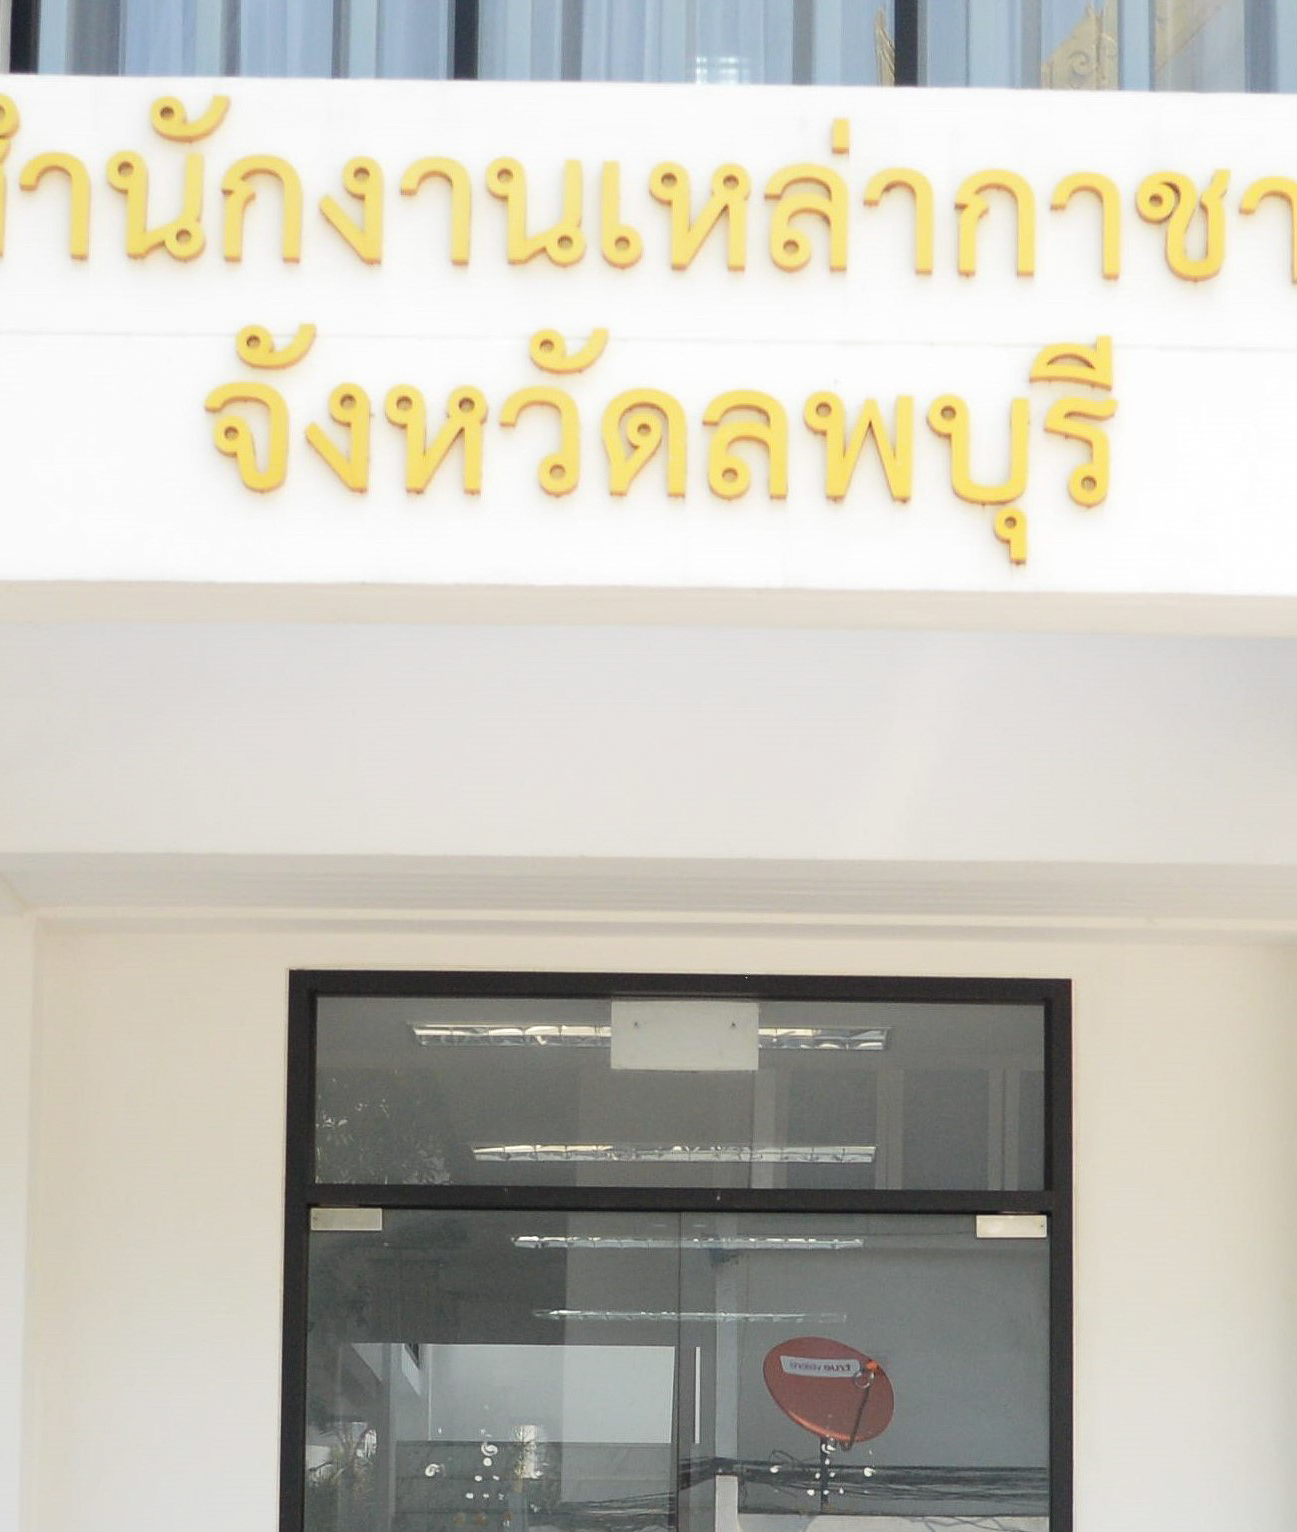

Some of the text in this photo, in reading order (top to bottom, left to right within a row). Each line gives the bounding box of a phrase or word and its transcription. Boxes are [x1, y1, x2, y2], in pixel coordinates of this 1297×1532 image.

[204, 322, 1120, 565] จังหวัดลพบุรี
